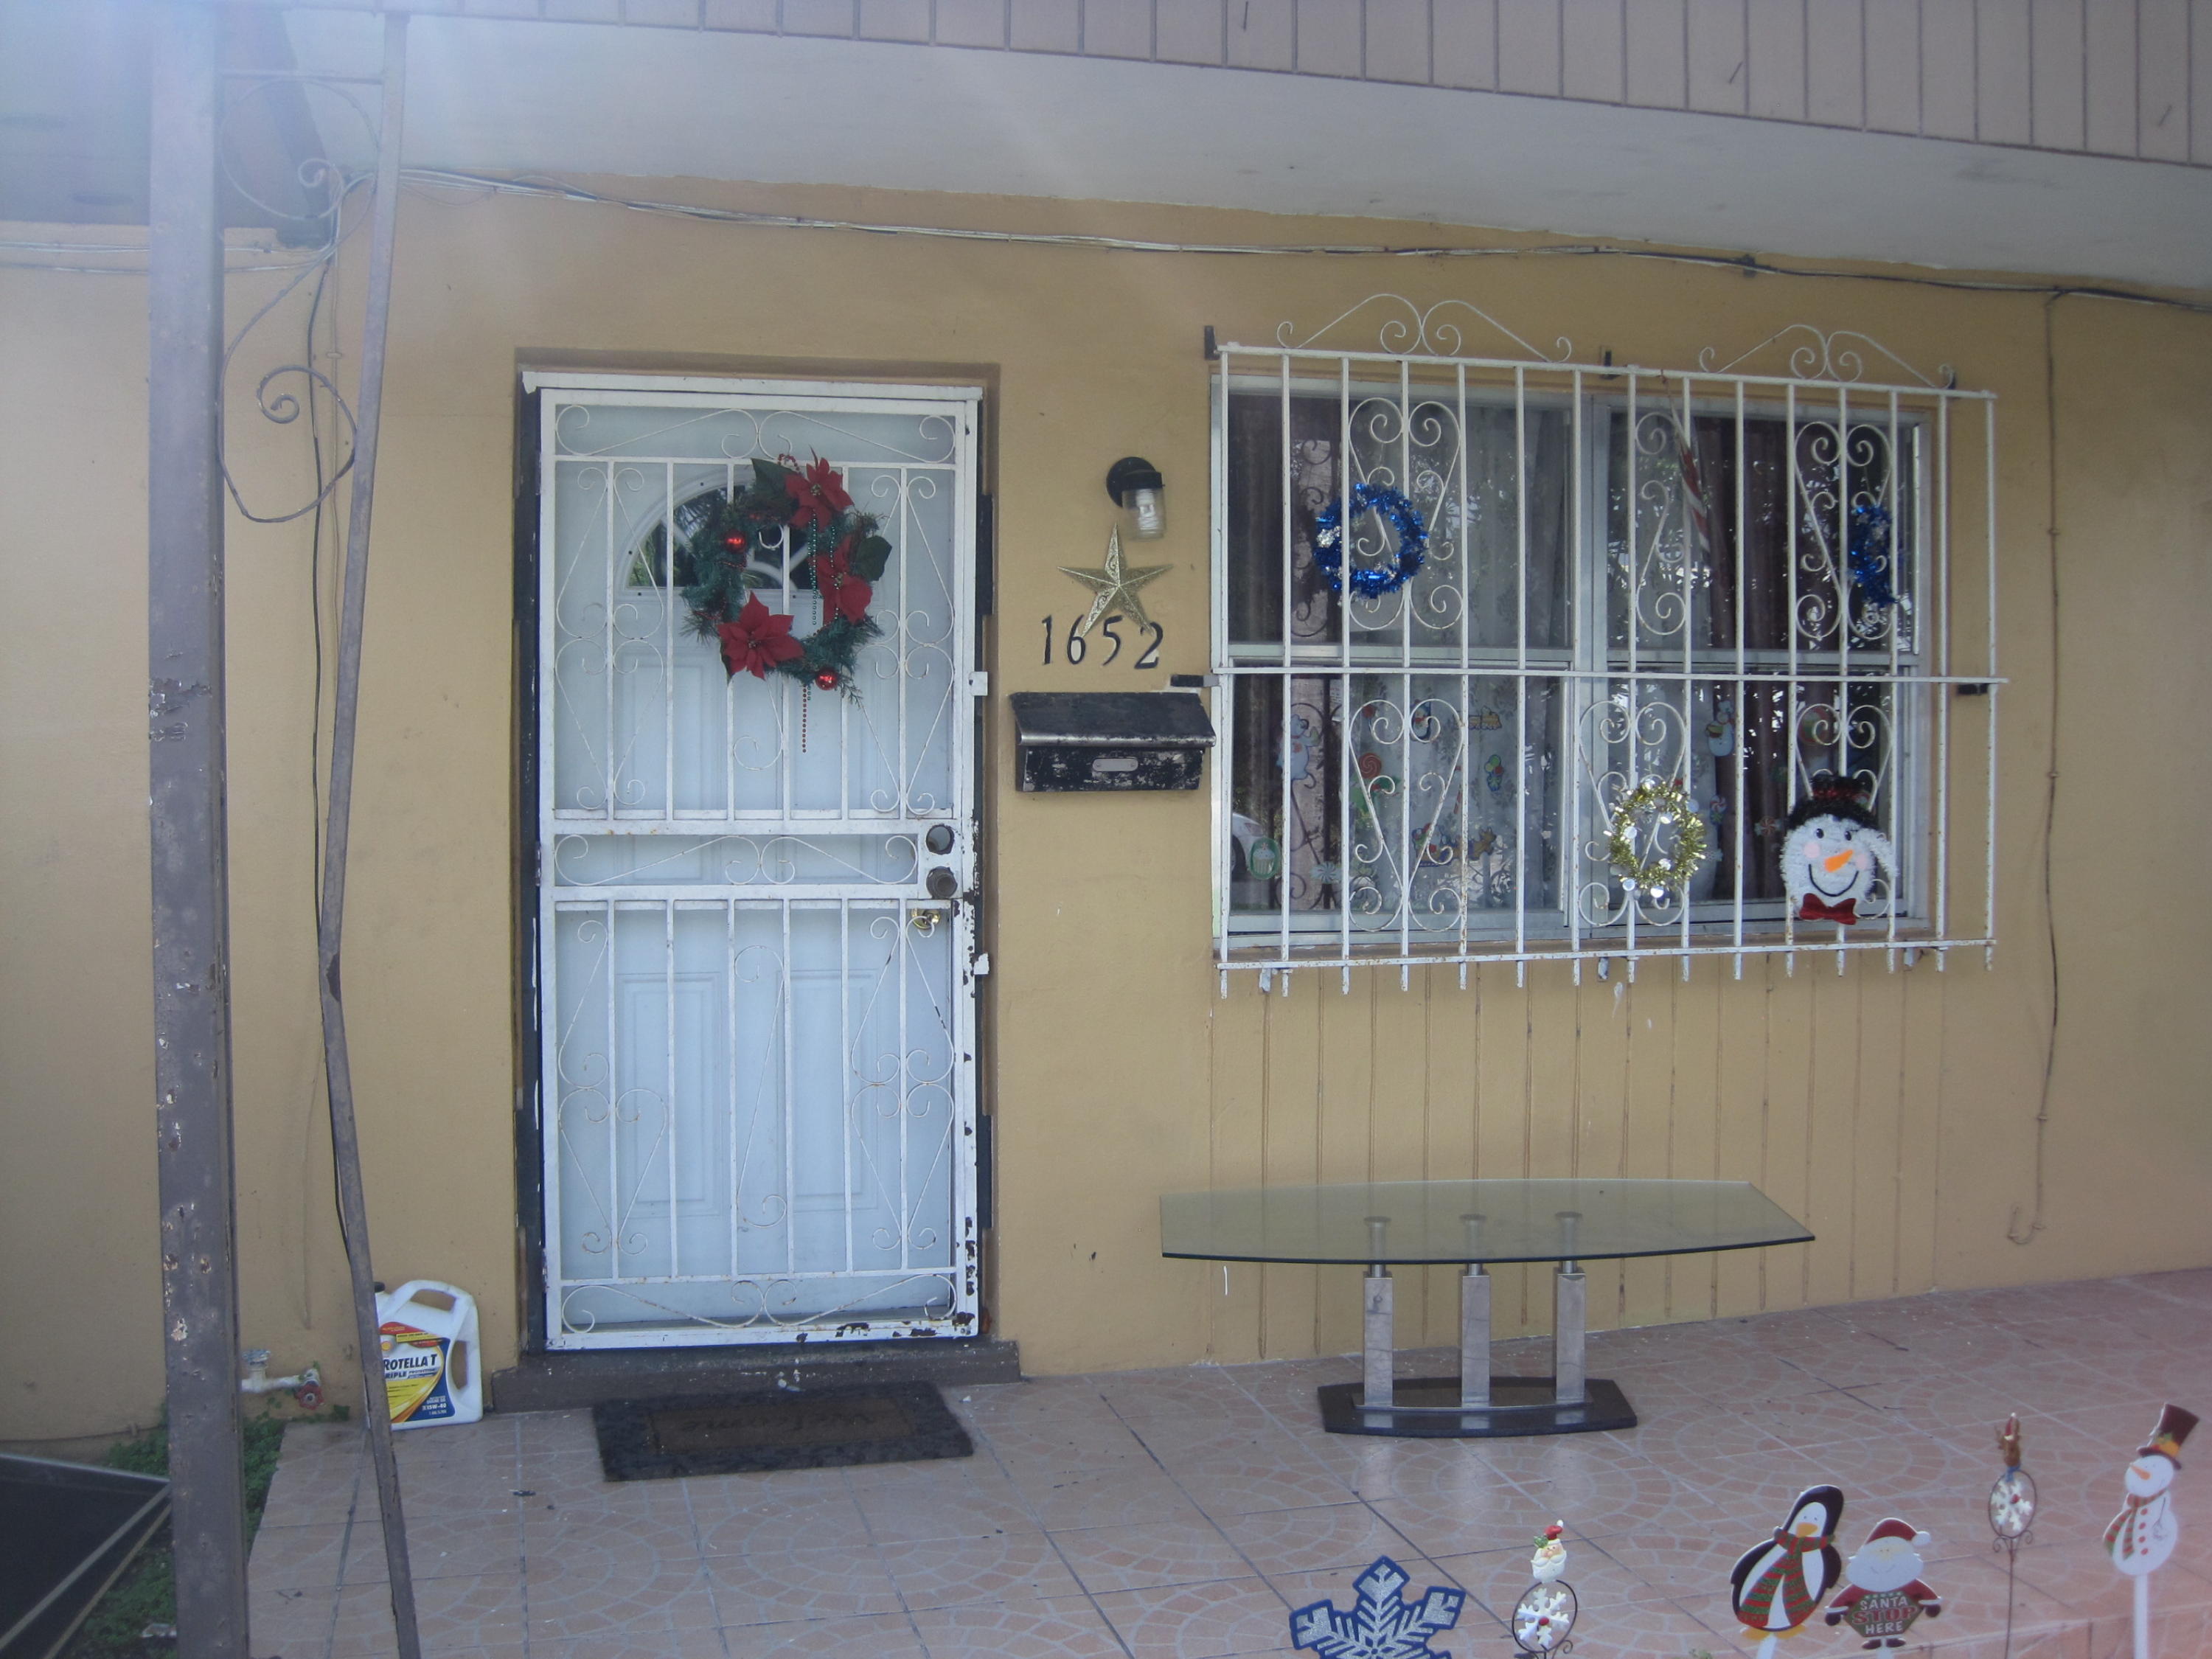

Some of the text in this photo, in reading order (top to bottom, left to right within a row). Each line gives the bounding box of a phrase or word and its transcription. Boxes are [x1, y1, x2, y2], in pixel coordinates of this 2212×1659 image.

[1042, 614, 1164, 669] 1652
[383, 1354, 438, 1371] ROTELLA T
[1860, 1596, 1908, 1611] SANTA
[1852, 1606, 1918, 1625] STOP
[1865, 1621, 1903, 1635] HERE
